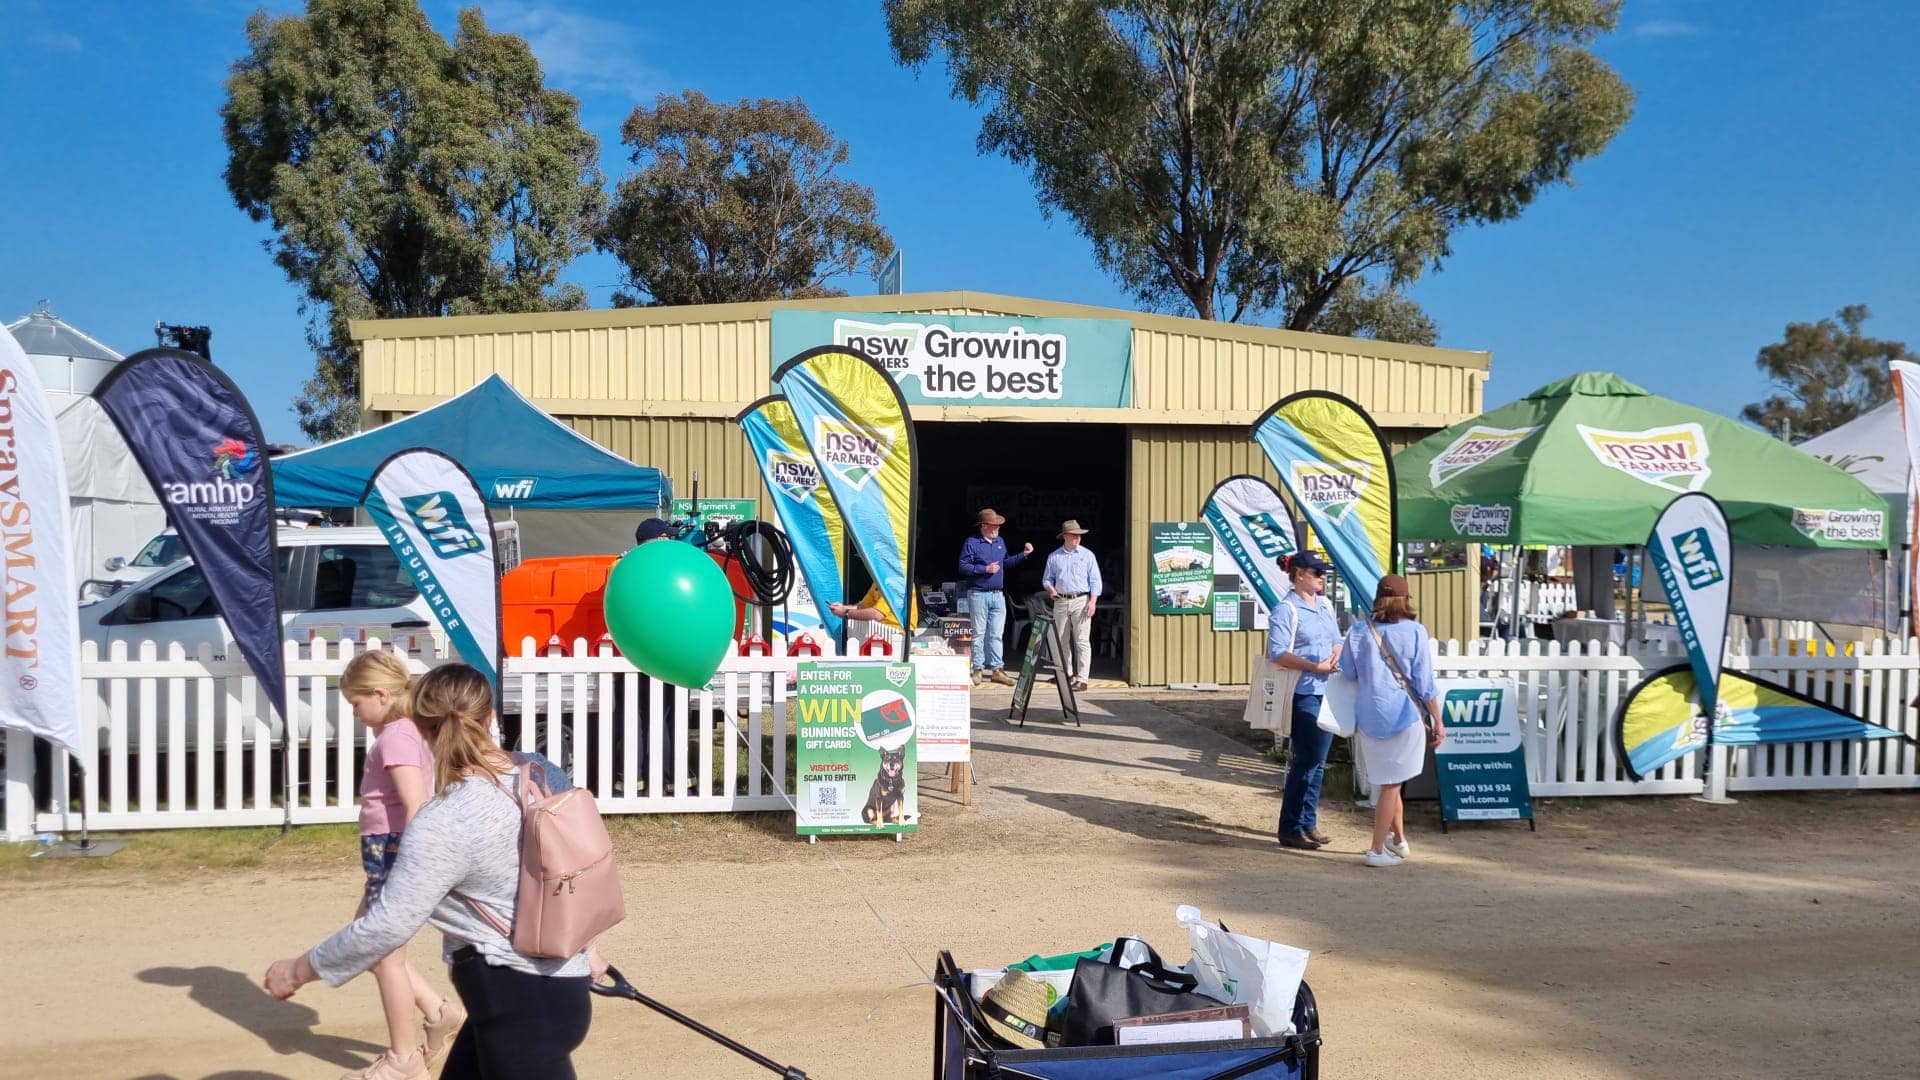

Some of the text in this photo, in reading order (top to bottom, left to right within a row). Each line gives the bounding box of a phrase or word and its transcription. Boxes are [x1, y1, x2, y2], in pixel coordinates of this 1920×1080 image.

[847, 335, 908, 355] nsw
[924, 329, 1061, 367] Growing
[924, 363, 1058, 394] the best
[826, 432, 879, 453] nsw
[1604, 442, 1687, 460] nsw
[826, 451, 880, 467] FARMERS
[1618, 461, 1703, 472] FARMERS
[775, 461, 816, 478] nsw
[775, 475, 817, 486] FARMERS
[1303, 473, 1355, 491] nsw
[496, 480, 534, 498] wfi
[1304, 490, 1358, 502] FARMERS
[698, 503, 728, 511] Farmers
[1471, 507, 1510, 521] Growing
[415, 494, 479, 553] wfi
[1828, 511, 1881, 525] Growing
[1249, 516, 1291, 554] wfi
[1469, 523, 1508, 533] the best
[1826, 526, 1881, 538] the best
[1216, 517, 1263, 587] INSURANCE
[1679, 531, 1720, 585] wfi
[387, 524, 460, 630] INSURANCE
[1660, 562, 1698, 651] INSURANCE
[800, 671, 852, 681] ENTER FOR
[800, 684, 863, 695] A CHANCE TO
[799, 698, 862, 723] WIN
[1446, 692, 1499, 722] wfi
[801, 727, 856, 738] BUNNINGS
[805, 740, 852, 749] GIFT CARDS
[809, 764, 849, 772] VISITORS
[1447, 761, 1512, 772] Enquire within
[804, 774, 823, 782] SCAN
[835, 774, 857, 782] ENTER
[1455, 784, 1512, 793] 1300 934 934
[1460, 795, 1510, 804] wfi.com.au
